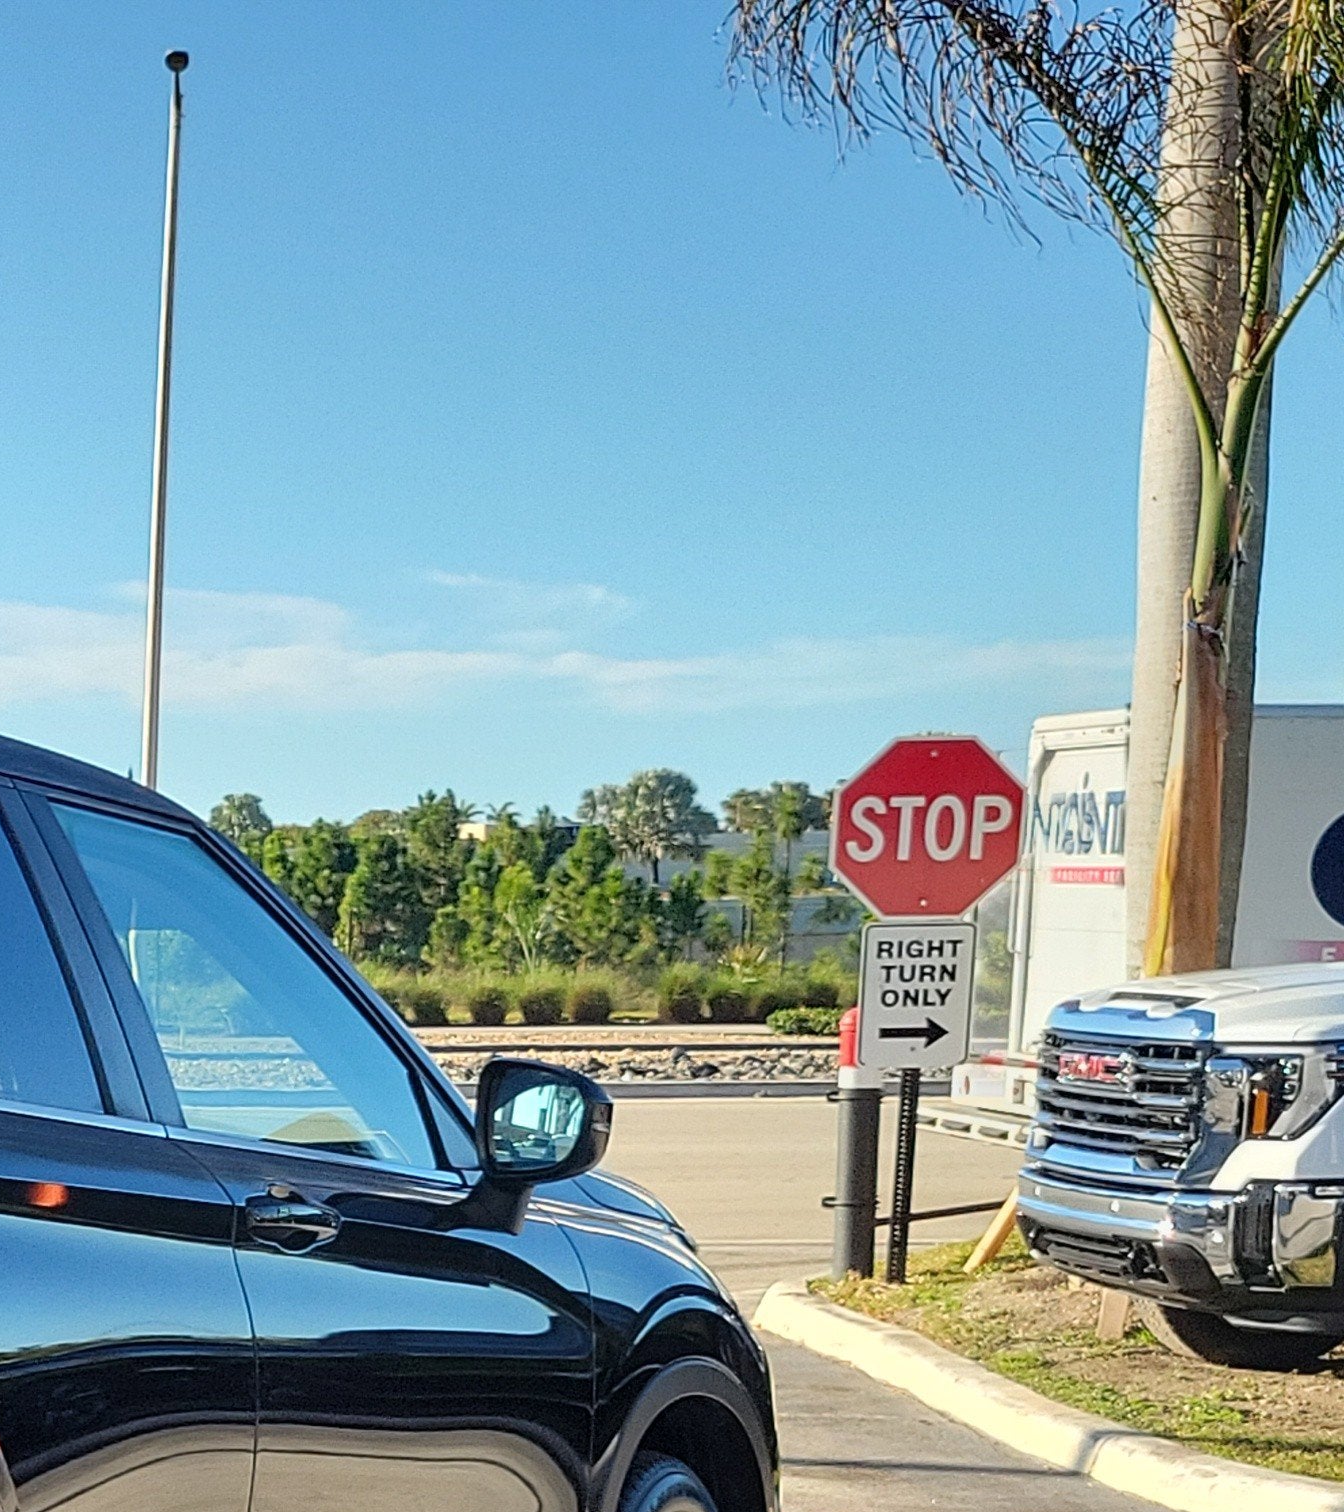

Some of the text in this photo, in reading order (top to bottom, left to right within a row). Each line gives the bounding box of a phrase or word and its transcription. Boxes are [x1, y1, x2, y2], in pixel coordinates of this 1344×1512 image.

[844, 795, 1013, 862] STOP
[876, 939, 964, 960] RIGHT
[880, 964, 957, 984] TURN
[881, 988, 952, 1008] ONLY
